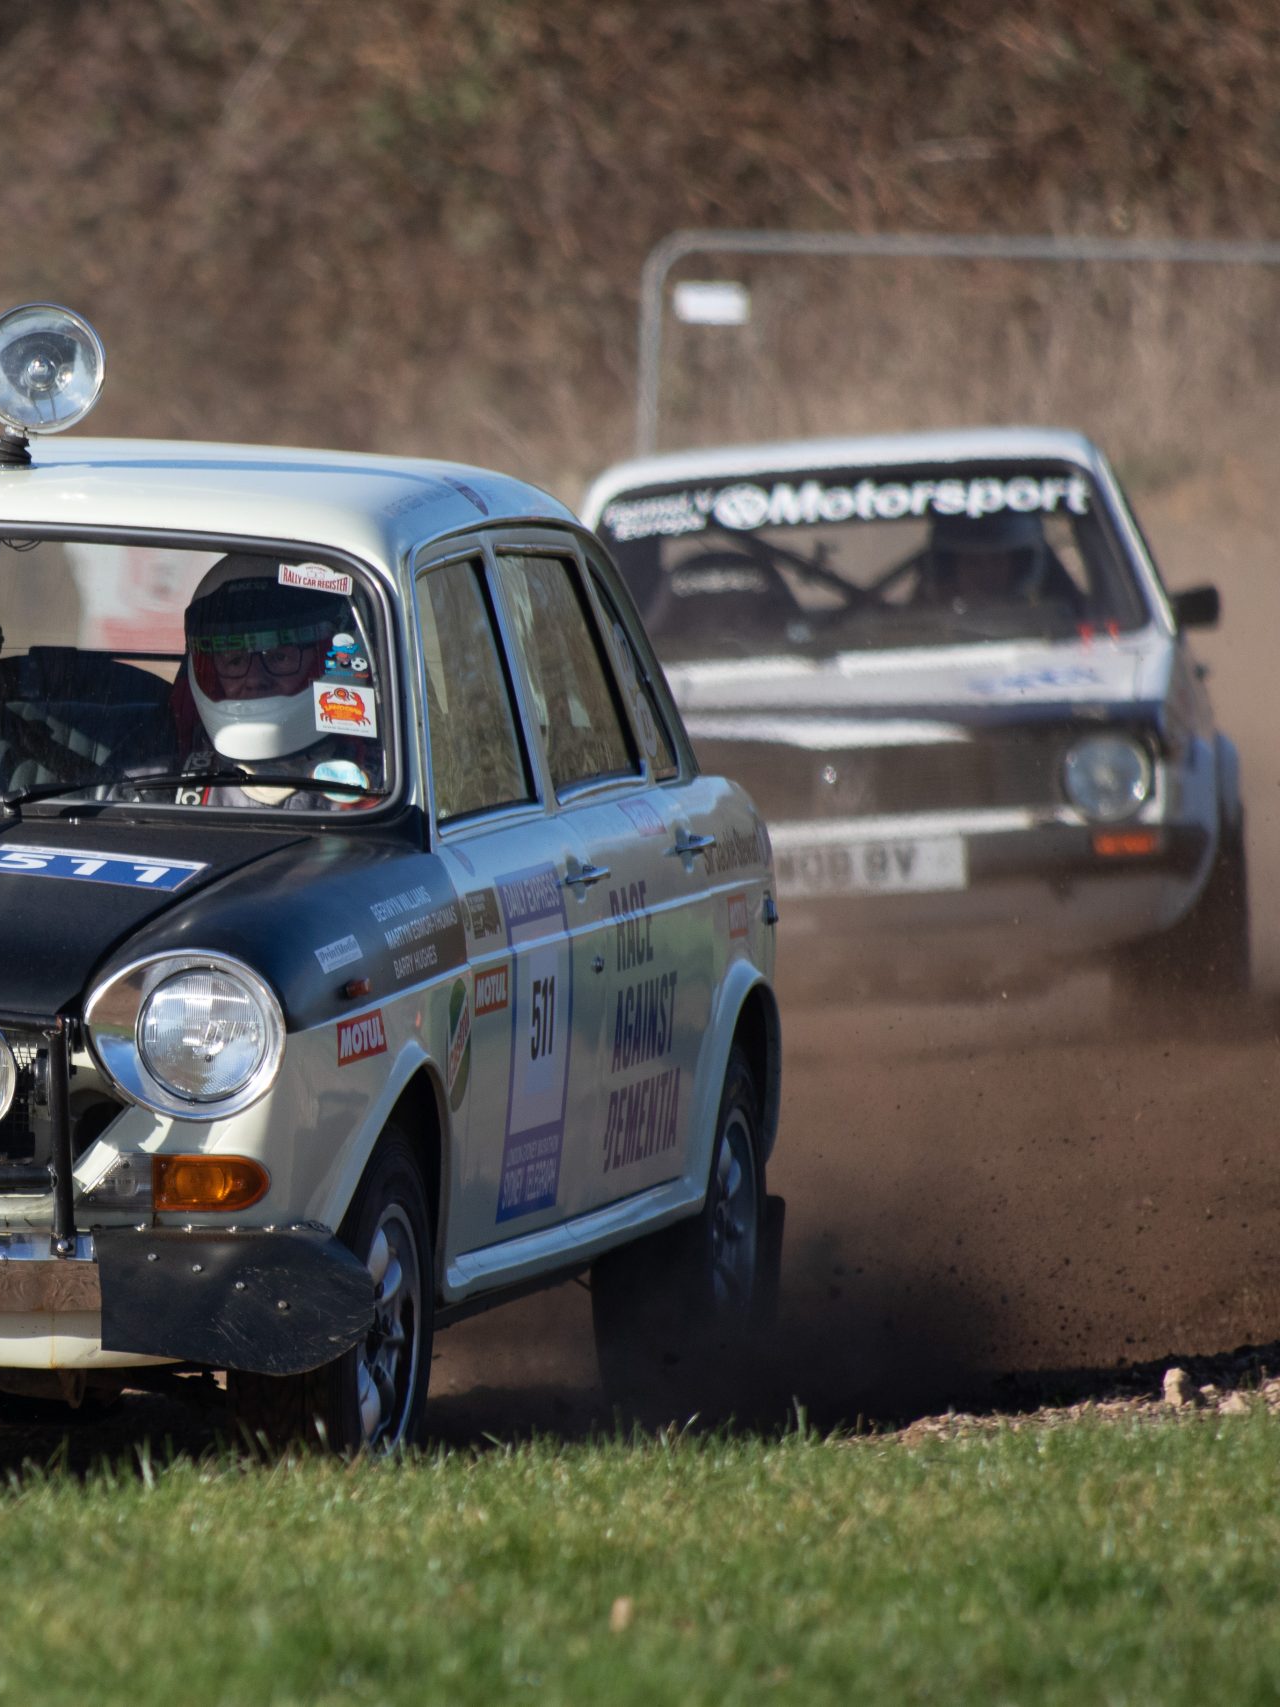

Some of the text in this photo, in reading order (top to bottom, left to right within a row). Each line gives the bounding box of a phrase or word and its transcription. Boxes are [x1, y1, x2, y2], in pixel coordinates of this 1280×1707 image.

[769, 477, 1088, 525] Motorsport
[283, 566, 348, 592] RALLY CAR REGISTER
[395, 885, 432, 915] WILLIAMS
[502, 877, 529, 919] DAILY
[524, 868, 561, 914] EXPRESS
[384, 921, 414, 951] MARTYN
[609, 880, 654, 972] RACE
[393, 952, 415, 980] BARRY
[414, 945, 439, 973] HUGHES
[475, 972, 507, 1009] MOTUL
[340, 1015, 385, 1058] MOTUL
[531, 975, 555, 1061] 511
[611, 970, 677, 1074] AGAINST
[603, 1067, 681, 1174] DEMENTIA
